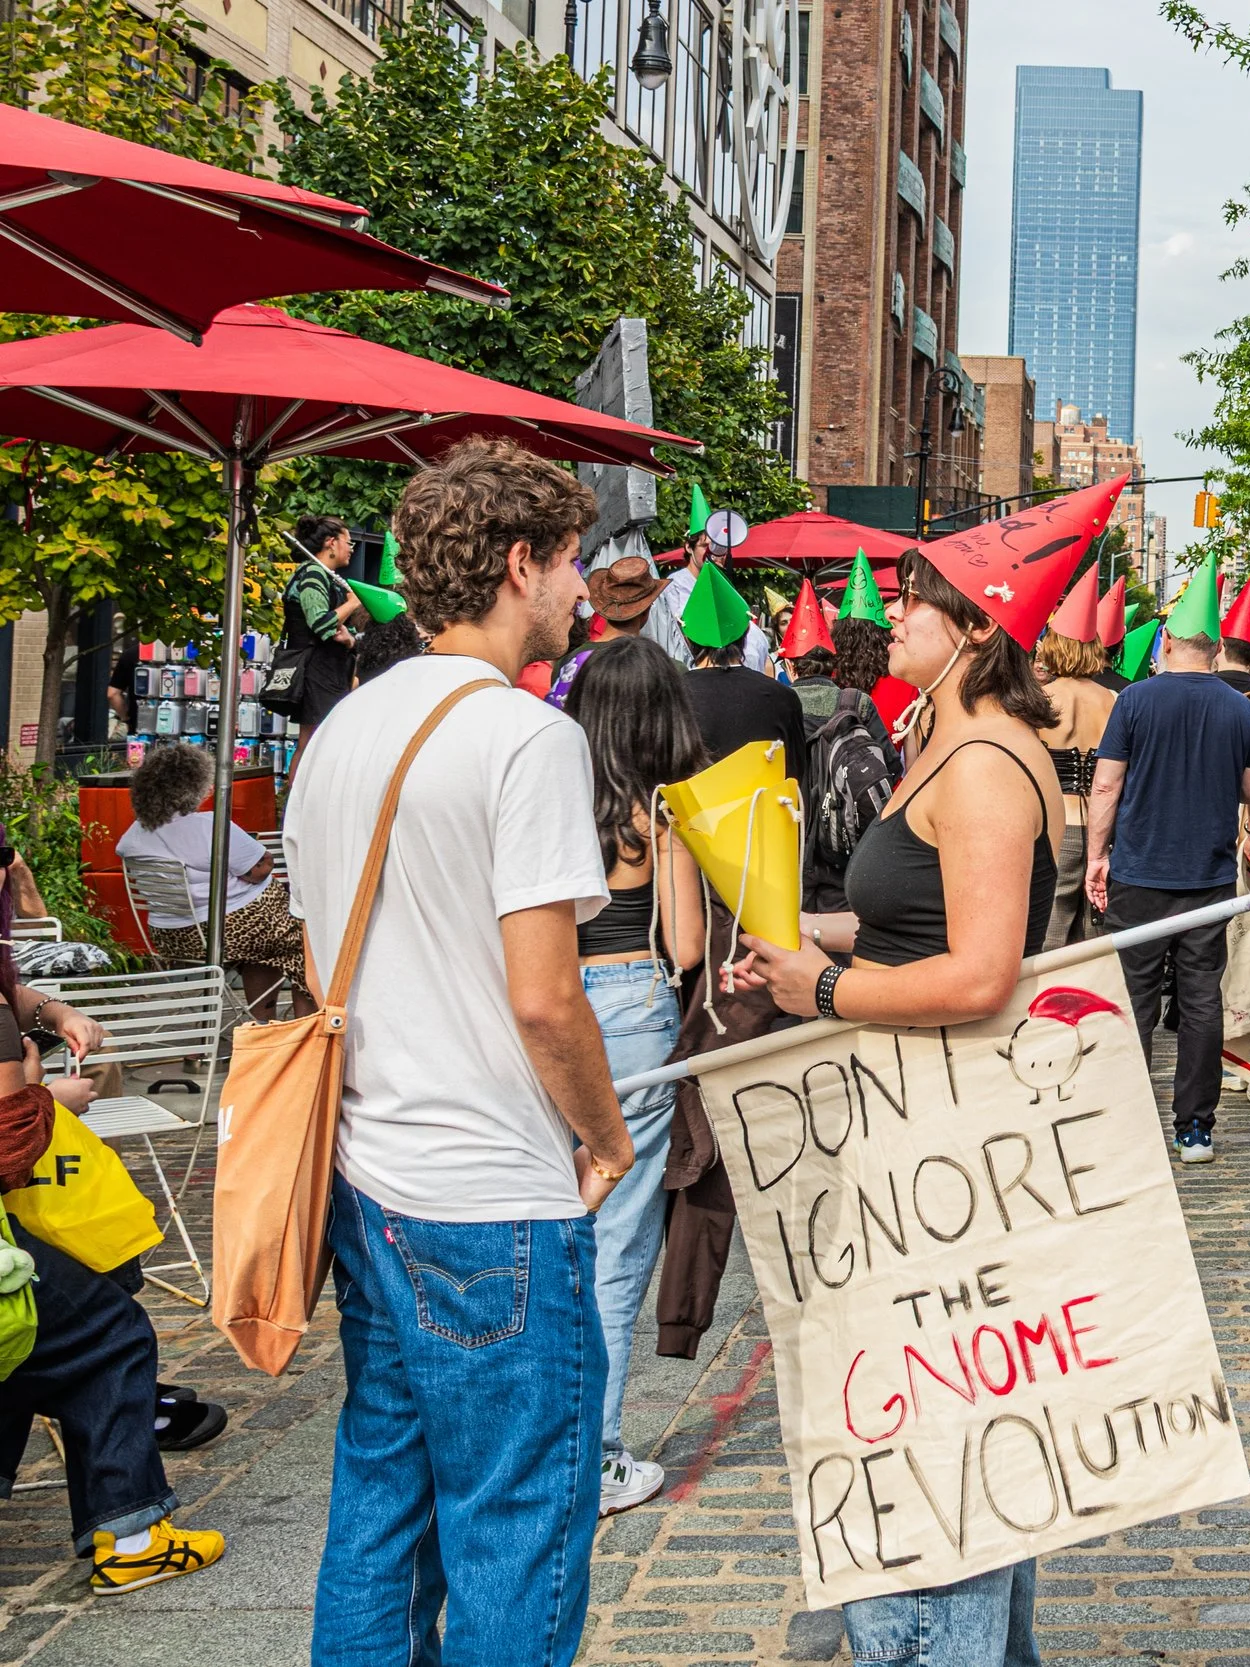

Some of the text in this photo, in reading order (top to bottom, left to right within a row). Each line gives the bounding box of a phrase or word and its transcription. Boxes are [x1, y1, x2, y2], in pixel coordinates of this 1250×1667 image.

[774, 1109, 1130, 1303] IGNORE
[842, 1294, 1118, 1444] GNOME
[893, 1262, 1011, 1329] THE
[807, 1370, 1231, 1583] REVOLUTION
